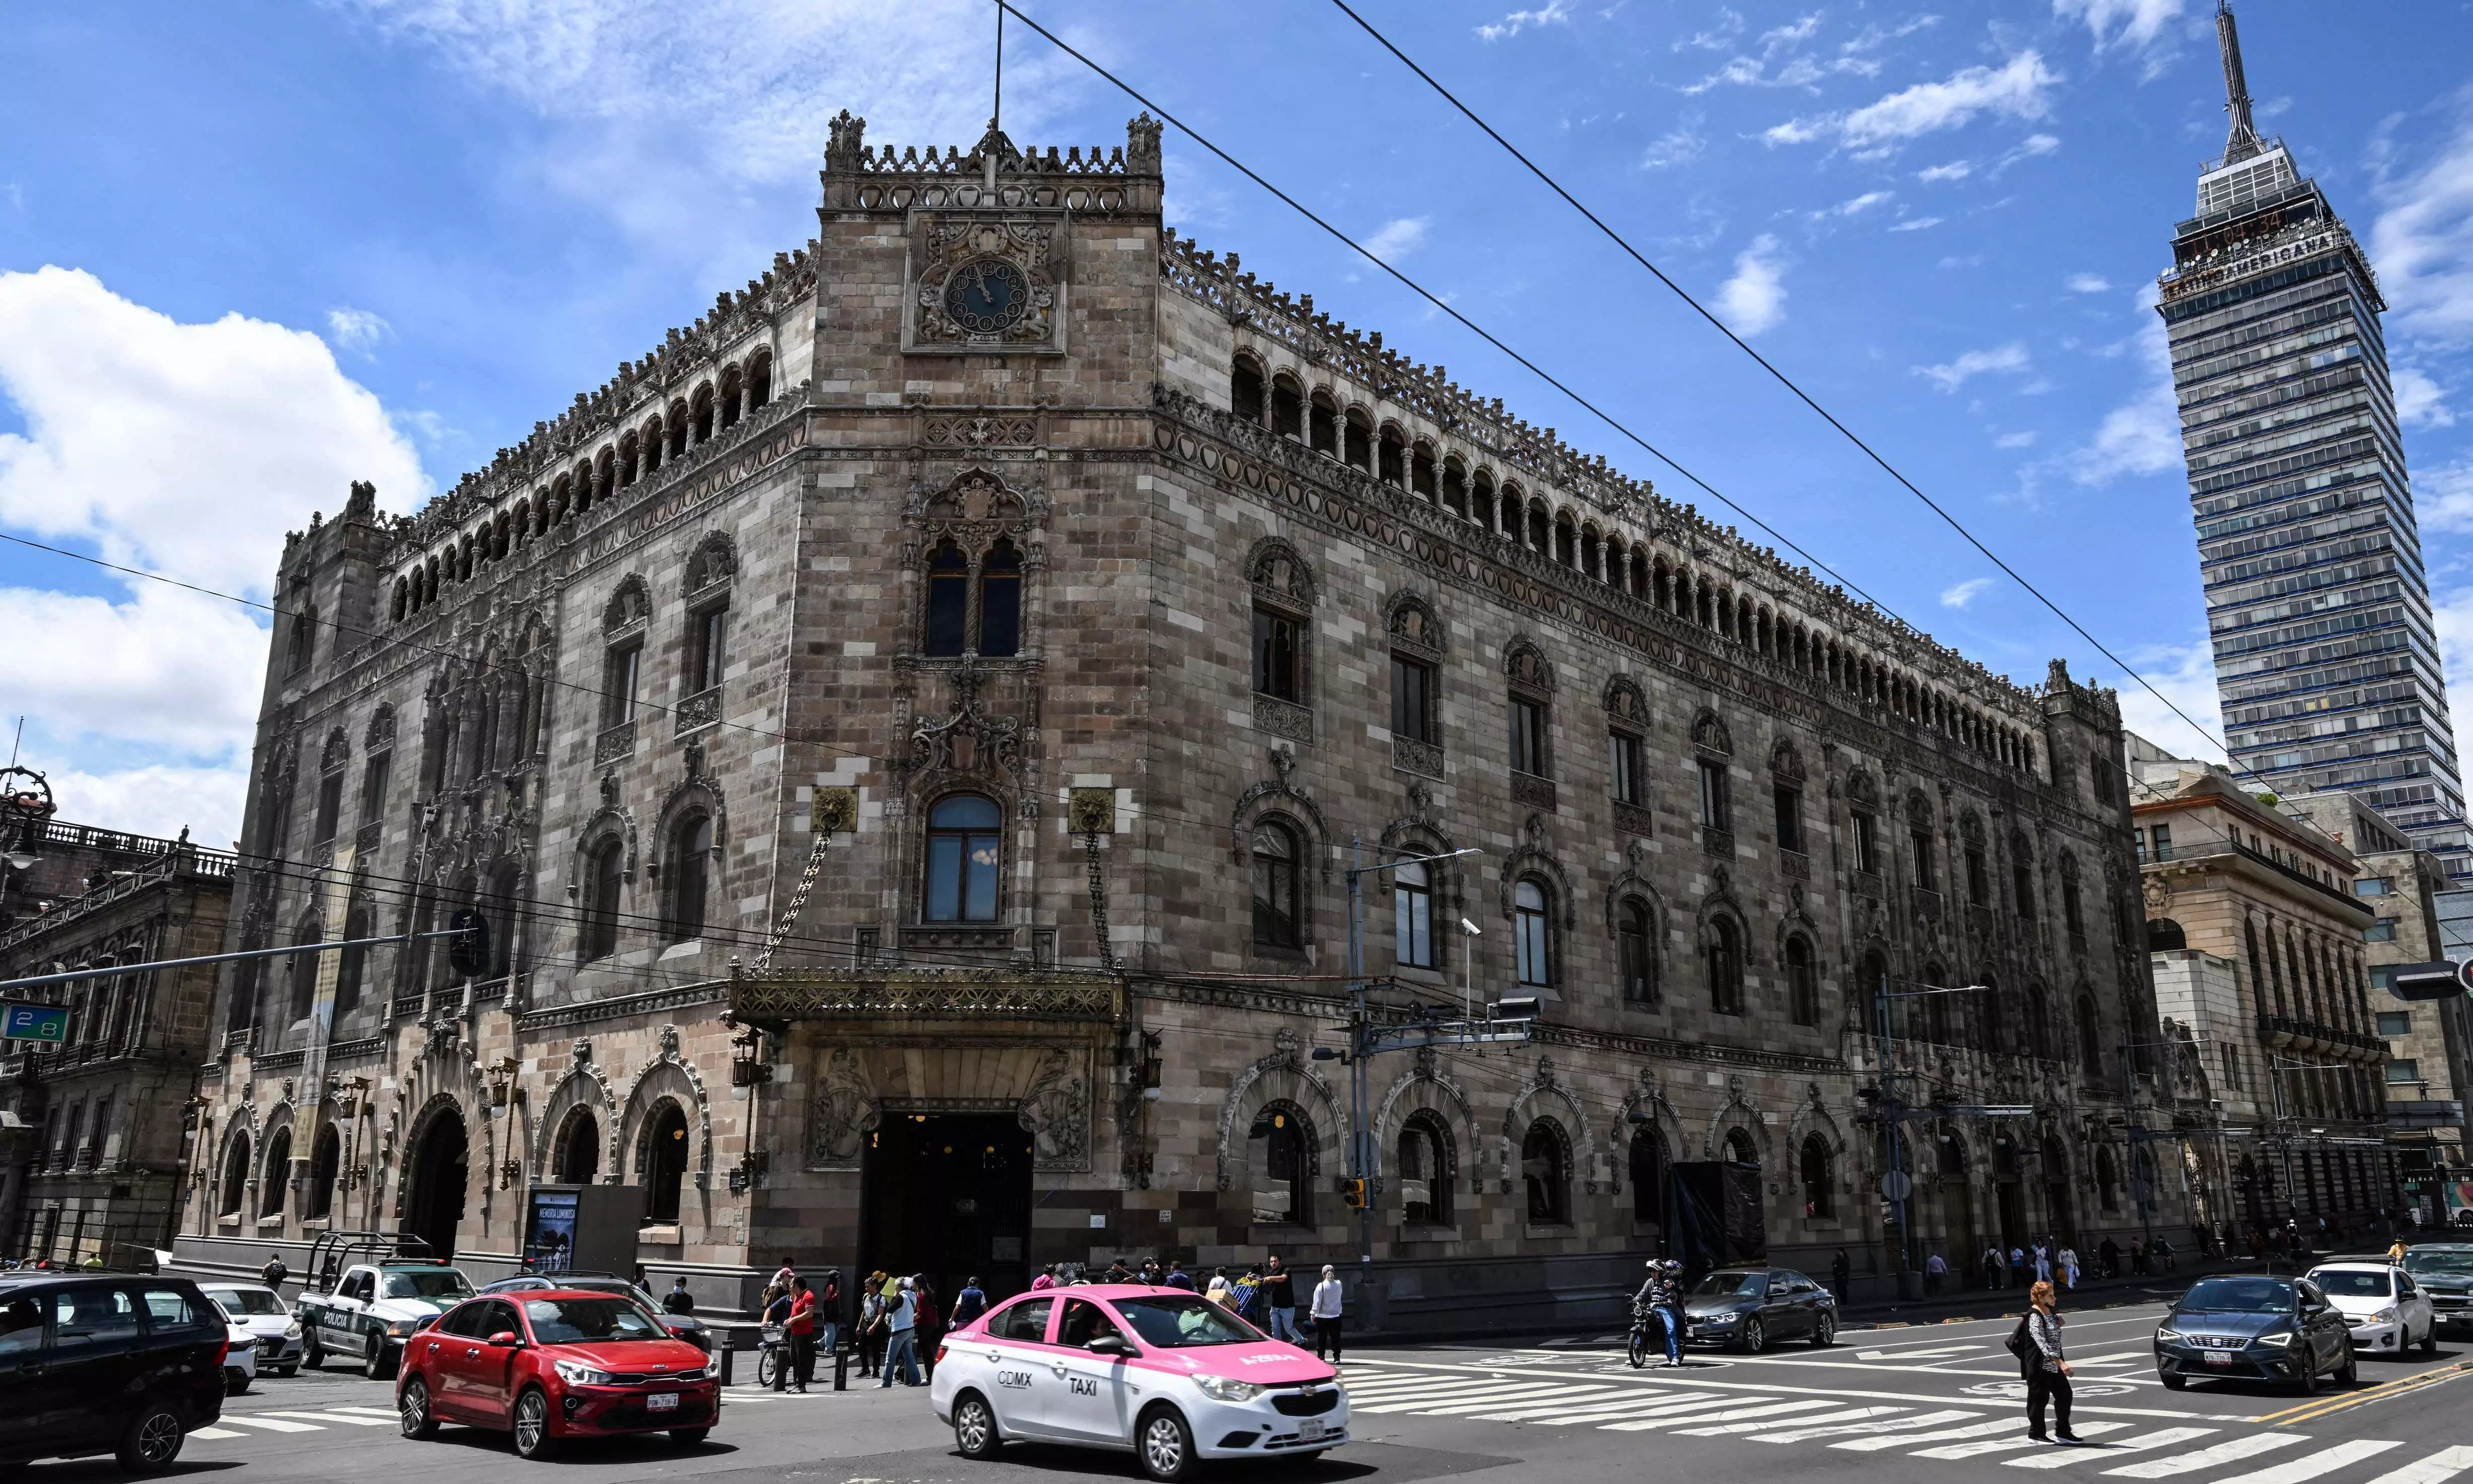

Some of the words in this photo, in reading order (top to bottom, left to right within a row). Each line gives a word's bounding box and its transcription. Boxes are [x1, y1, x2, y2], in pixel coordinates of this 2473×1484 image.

[2193, 210, 2282, 256] 11:04:34
[969, 267, 976, 277] 11
[984, 264, 993, 273] 12
[957, 277, 966, 287] 10
[1011, 277, 1017, 288] 2
[954, 291, 960, 301] 9
[1015, 292, 1021, 301] 3
[958, 305, 963, 315] 8
[1010, 305, 1016, 315] 4
[968, 315, 974, 325] 7
[983, 319, 990, 329] 6
[999, 315, 1005, 325] 5
[16, 1012, 33, 1025] 2
[41, 1023, 57, 1036] 8
[539, 1208, 556, 1219] MEMORIA
[556, 1208, 575, 1219] LUMINOSA
[324, 1311, 347, 1328] POLICIA
[998, 1370, 1032, 1386] CDMX
[1070, 1378, 1097, 1396] TAXI
